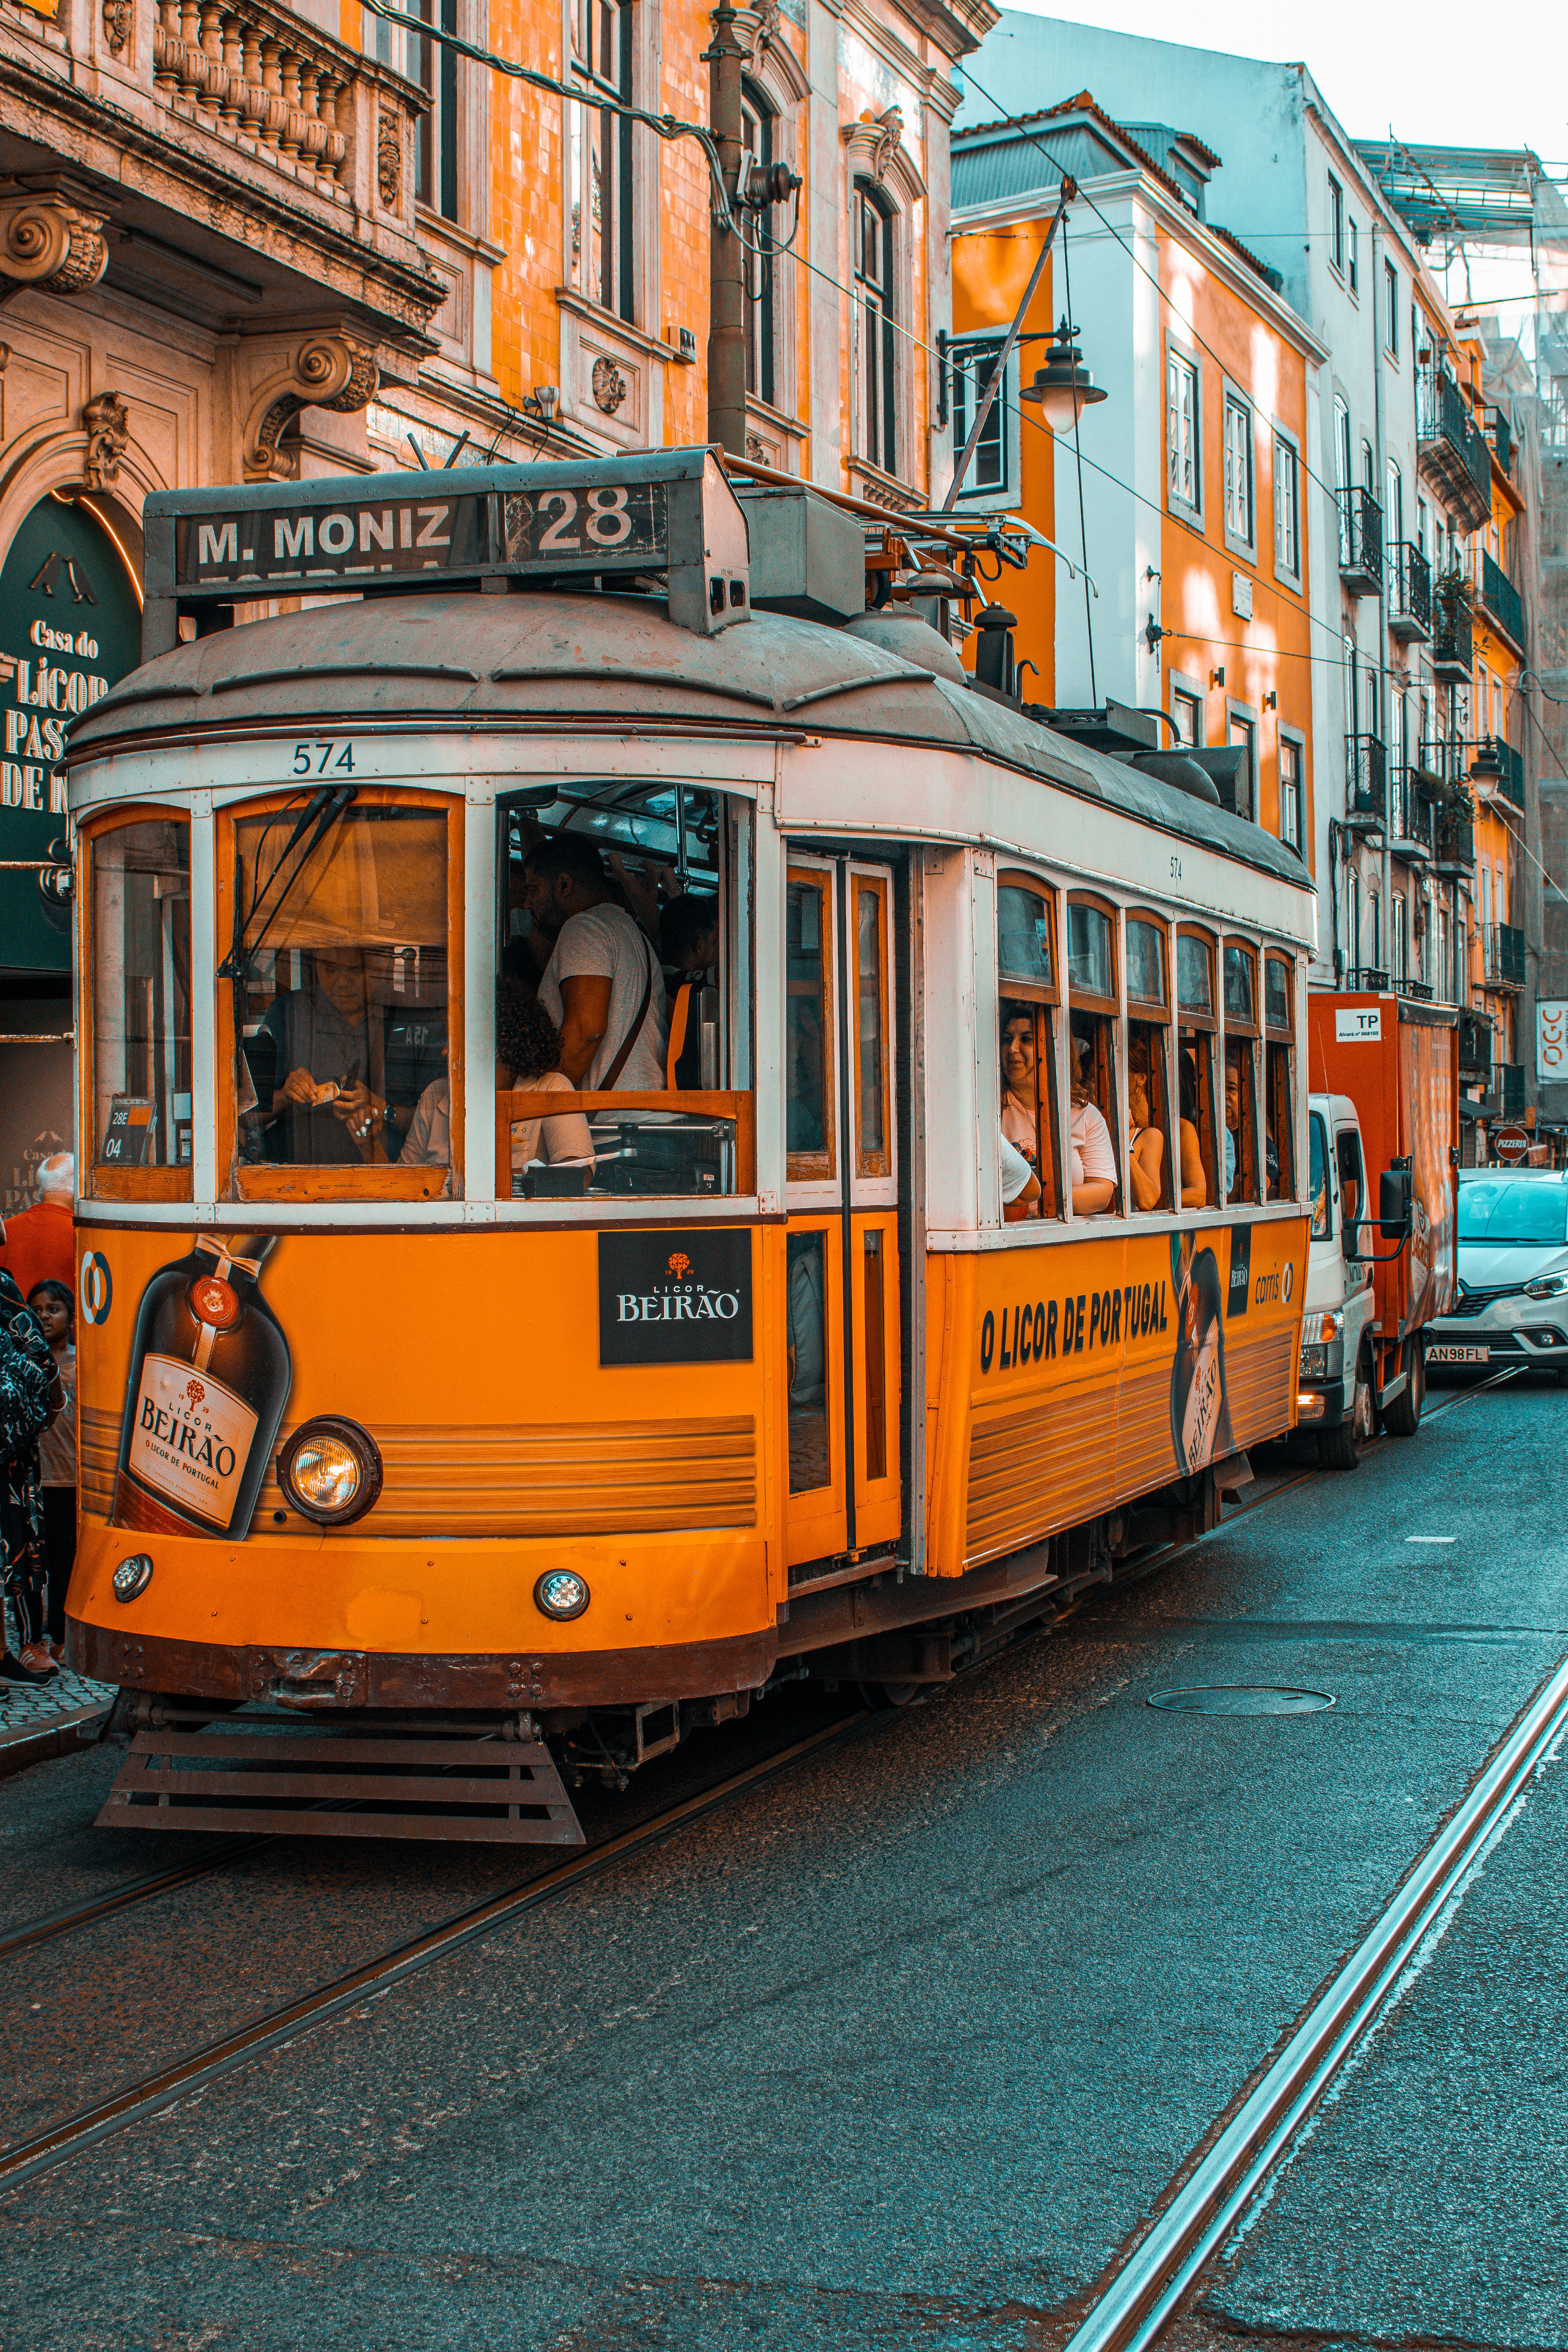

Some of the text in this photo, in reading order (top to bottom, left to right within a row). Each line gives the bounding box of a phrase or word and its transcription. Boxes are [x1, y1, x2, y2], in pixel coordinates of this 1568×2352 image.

[199, 505, 450, 564] M. MONIZ
[537, 486, 632, 551] 28
[30, 619, 99, 659] Casa do
[293, 743, 356, 774] 574
[0, 761, 44, 811] DE
[1171, 856, 1182, 881] 574
[1356, 1015, 1379, 1029] TP
[113, 1112, 129, 1125] 28E
[106, 1138, 122, 1158] 04
[654, 1285, 704, 1293] LICOR
[1255, 1261, 1279, 1305] carris
[616, 1290, 739, 1321] BEIRÃO
[980, 1280, 1168, 1372] O LICOR DE PORTUGAL
[169, 1401, 212, 1432] LICOR
[140, 1396, 236, 1477] BEIRÃO
[145, 1439, 220, 1490] O LICOR DE PORTUGAL
